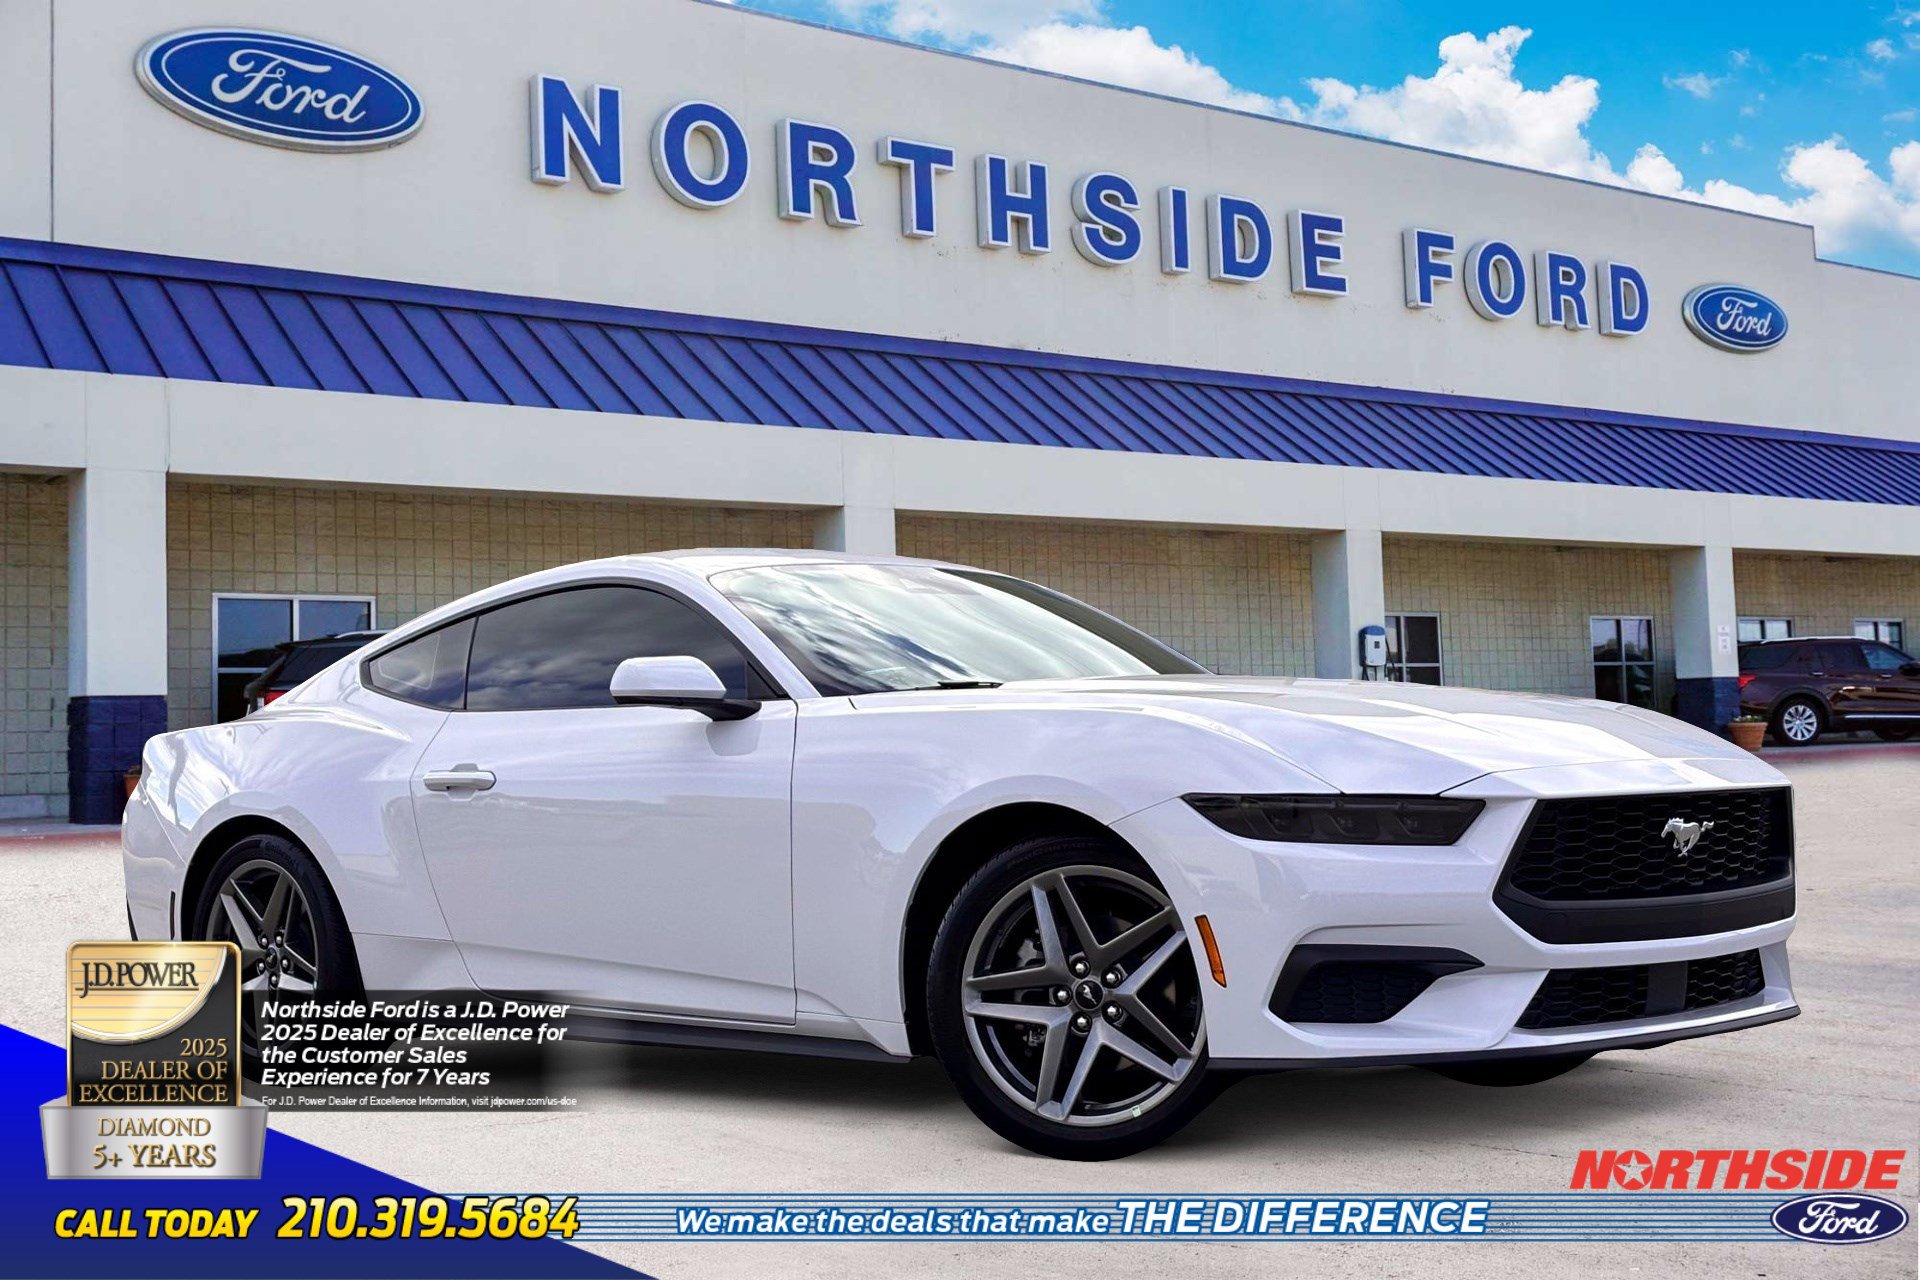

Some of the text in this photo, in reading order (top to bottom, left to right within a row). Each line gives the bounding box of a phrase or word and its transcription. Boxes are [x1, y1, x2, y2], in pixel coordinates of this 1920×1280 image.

[210, 48, 370, 126] Ford
[529, 73, 1650, 338] NORTHSIDE FORD
[1716, 294, 1773, 338] Ford
